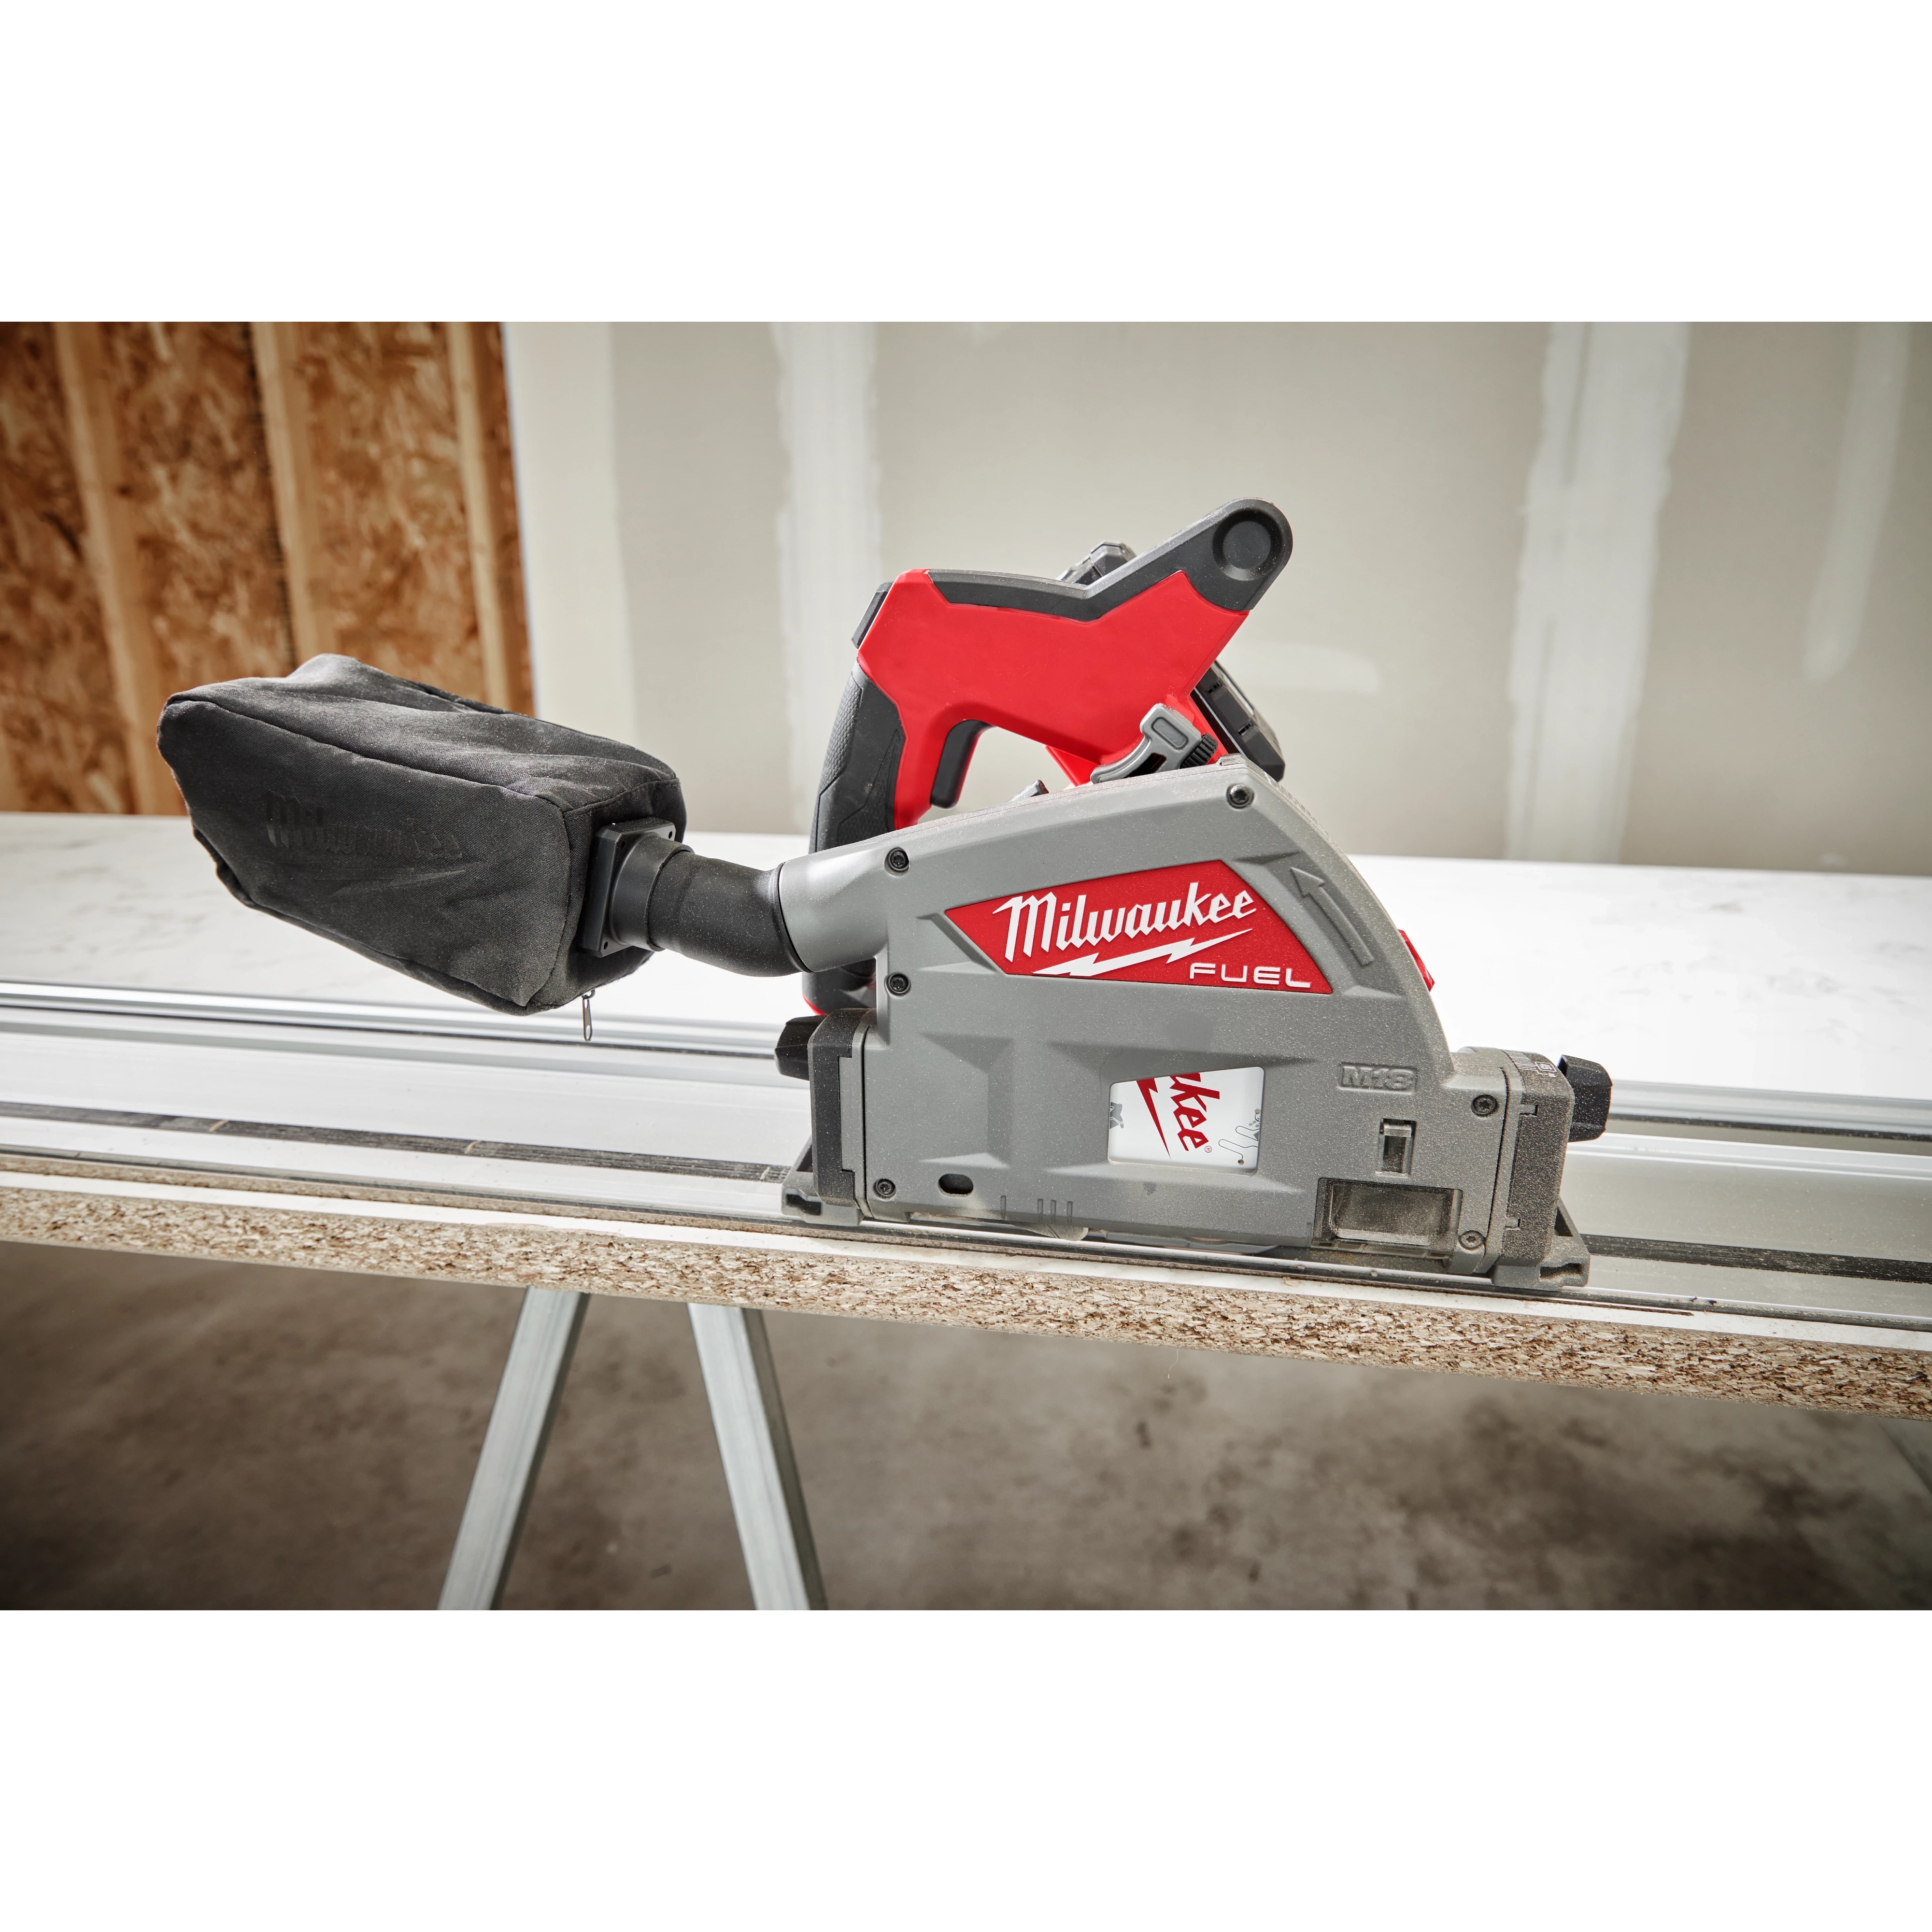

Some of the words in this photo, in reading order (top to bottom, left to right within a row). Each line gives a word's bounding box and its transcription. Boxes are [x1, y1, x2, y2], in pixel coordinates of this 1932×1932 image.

[993, 882, 1257, 963] Milwaukee
[1190, 963, 1311, 988] FUEL
[1342, 1065, 1415, 1090] M18
